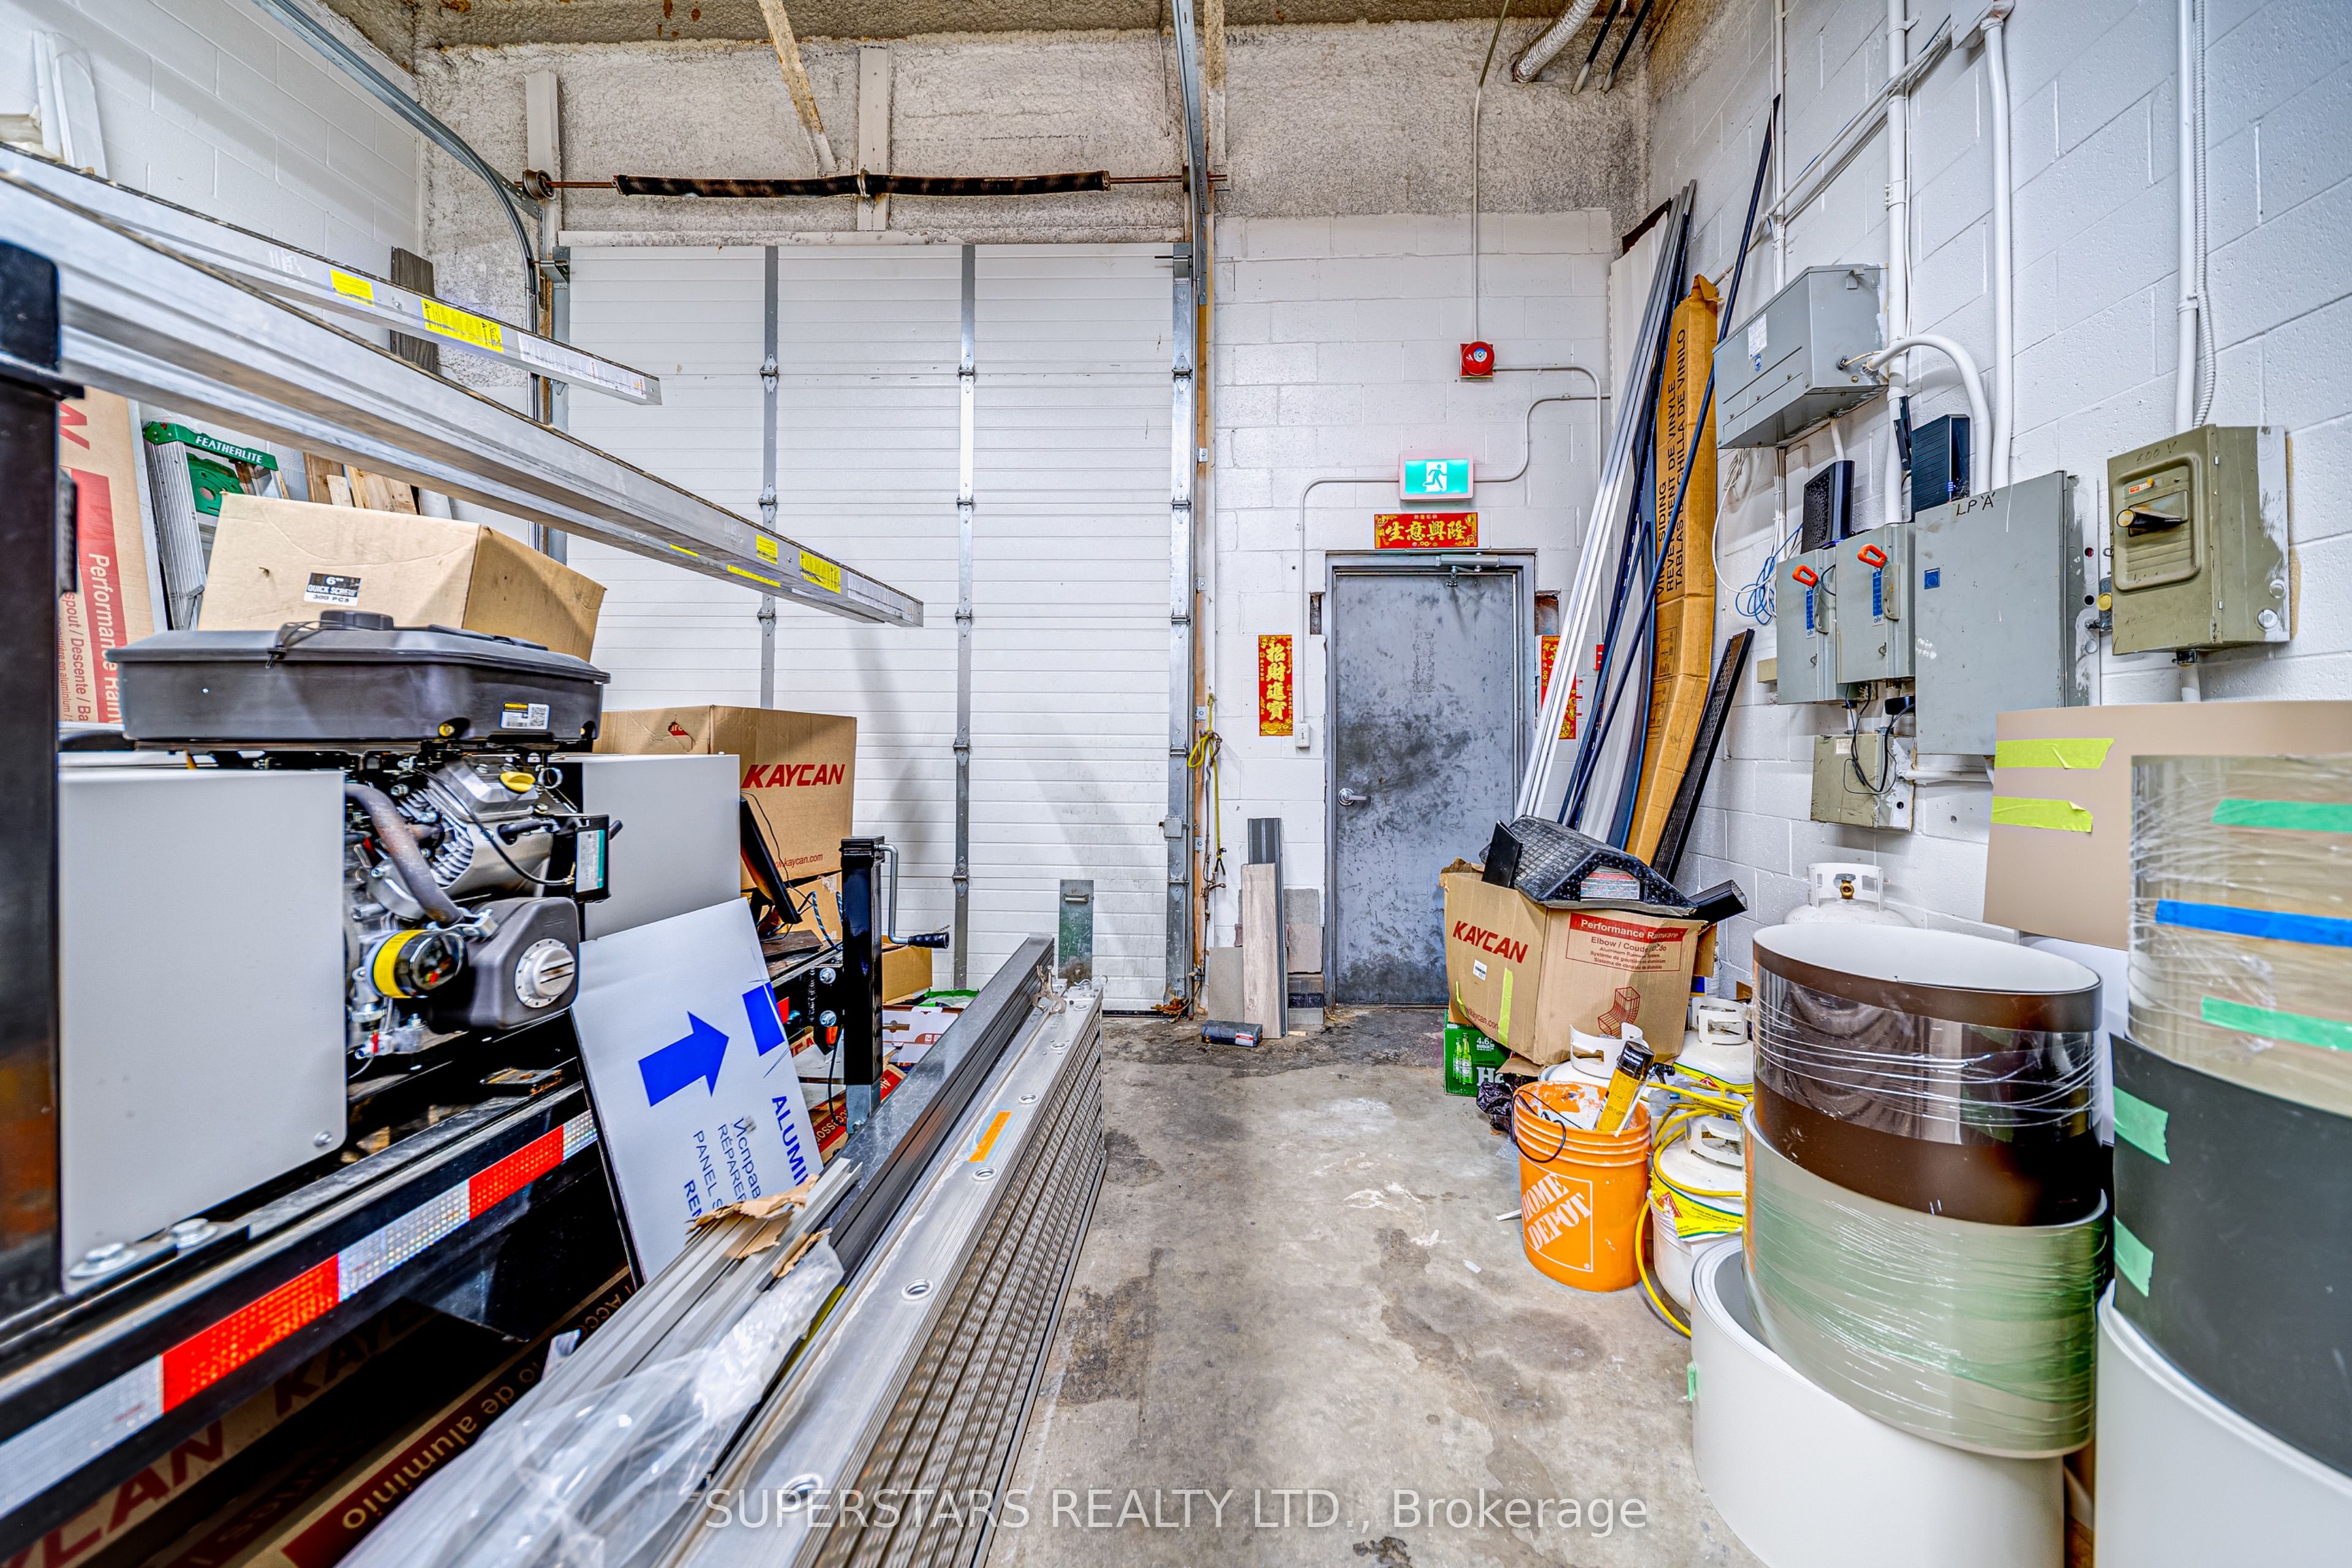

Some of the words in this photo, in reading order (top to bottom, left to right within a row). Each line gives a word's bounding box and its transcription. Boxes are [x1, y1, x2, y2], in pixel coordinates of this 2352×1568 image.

[1677, 328, 1686, 398] VINILO
[1667, 379, 1676, 443] VINYLE
[1678, 402, 1686, 419] DE
[196, 435, 263, 464] FEATHERLITE
[1668, 443, 1676, 472] DE
[1385, 519, 1467, 541] 生意興隆
[1658, 481, 1667, 542] SIDING
[1675, 519, 1684, 590] TABLAS
[307, 584, 330, 594] QUICK
[70, 638, 88, 695] Descente
[1266, 643, 1287, 721] 招財進寶
[60, 670, 72, 712] aluminium
[740, 764, 845, 789] KAYCAN
[1452, 920, 1529, 964] KAYCAN
[1581, 919, 1645, 938] Performance
[1591, 936, 1617, 947] Elbow
[693, 1129, 718, 1197] PANEL
[1521, 1172, 1569, 1223] HOME
[1527, 1192, 1591, 1251] DEPOT
[480, 1383, 515, 1415] de
[341, 1414, 479, 1531] aluminio
